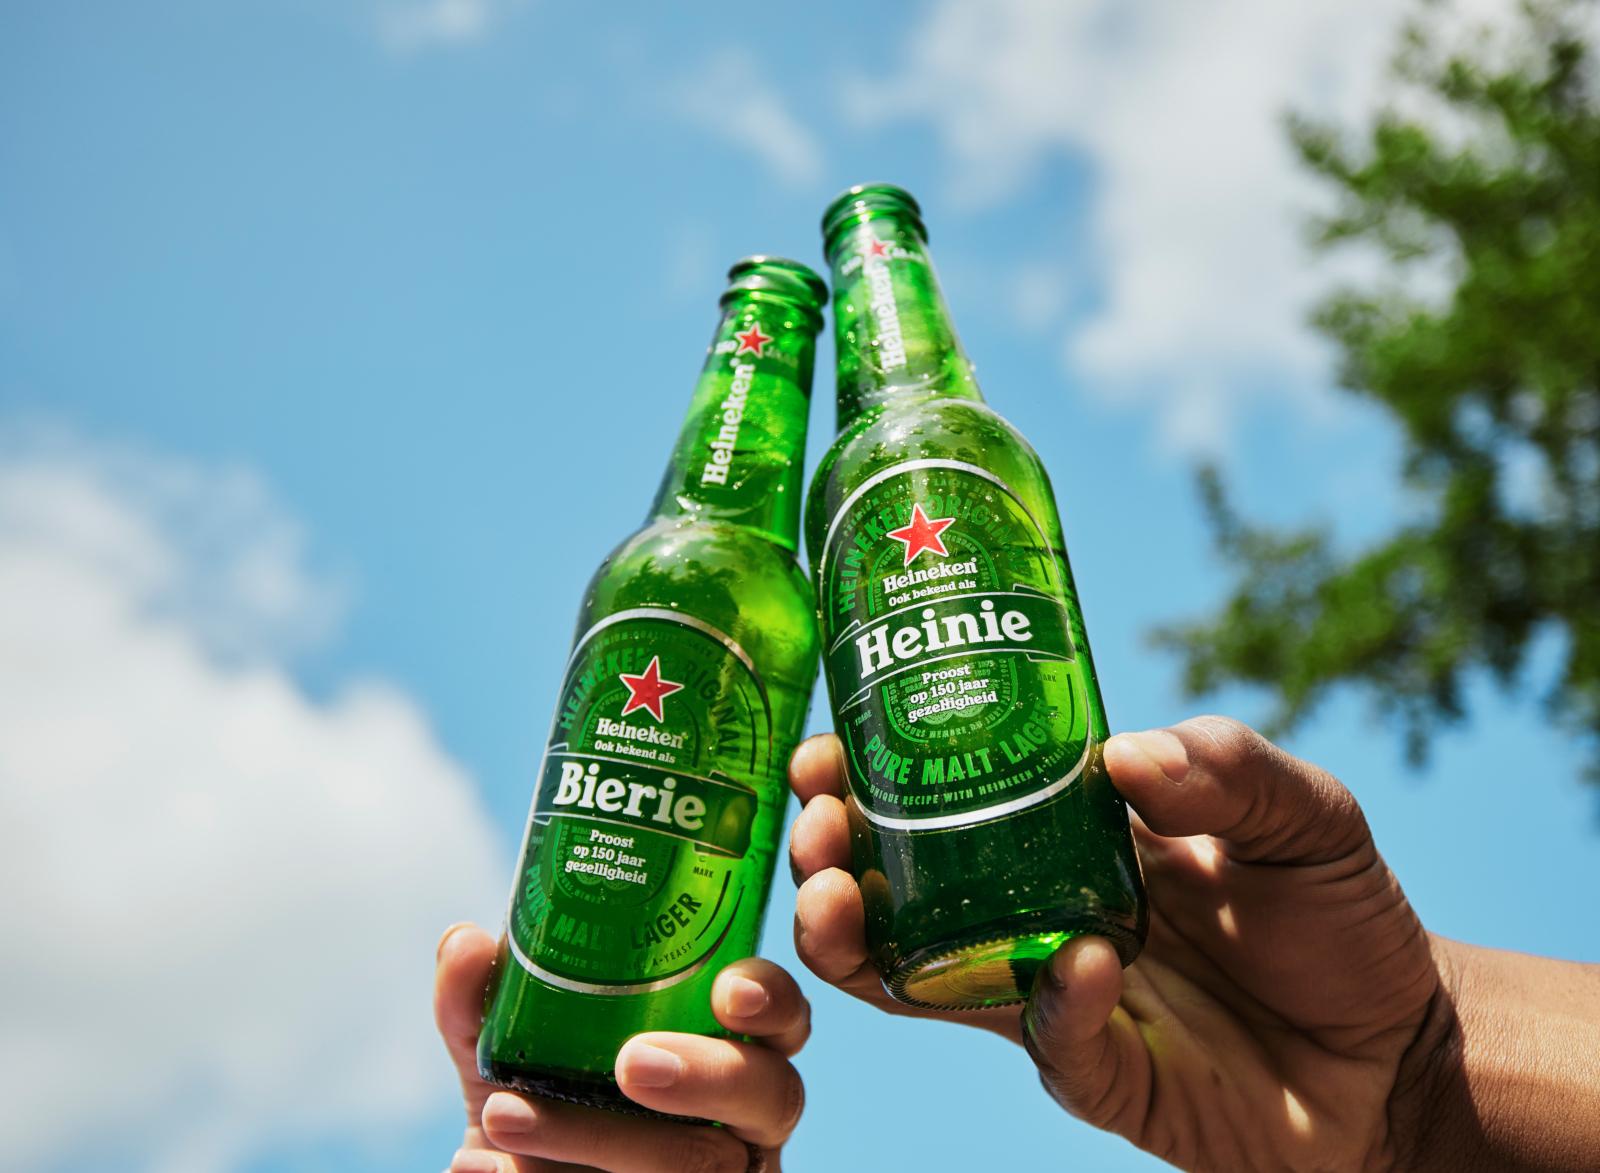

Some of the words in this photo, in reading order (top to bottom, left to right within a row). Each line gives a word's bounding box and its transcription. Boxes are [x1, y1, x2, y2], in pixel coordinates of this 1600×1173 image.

[701, 363, 756, 486] Heineken
[882, 561, 977, 594] Heineken
[888, 593, 911, 607] Ook
[912, 583, 956, 600] bekend
[958, 579, 977, 590] als
[856, 600, 1033, 680] Heinie
[921, 664, 972, 685] Proost
[910, 691, 928, 704] op
[929, 681, 956, 698] 150
[958, 678, 990, 694] jaar
[907, 690, 999, 723] gezelligheid
[595, 717, 684, 749] Heineken
[594, 739, 614, 752] Ook
[615, 741, 657, 760] bekend
[658, 750, 676, 764] als
[863, 733, 914, 785] PURE
[921, 747, 993, 785] MALT
[552, 760, 706, 832] Bierie
[869, 783, 900, 805] UNIQUE
[902, 794, 940, 806] RECIPE
[943, 788, 974, 803] WITH
[978, 769, 1034, 796] HEINEKEN
[589, 829, 635, 849] Proost
[573, 845, 590, 859] op
[591, 845, 615, 861] 150
[614, 850, 647, 868] jaar
[564, 860, 648, 885] gezelligheid
[693, 865, 715, 879] MARK
[630, 892, 703, 950] LAGER
[652, 941, 692, 967] A-YEAST
